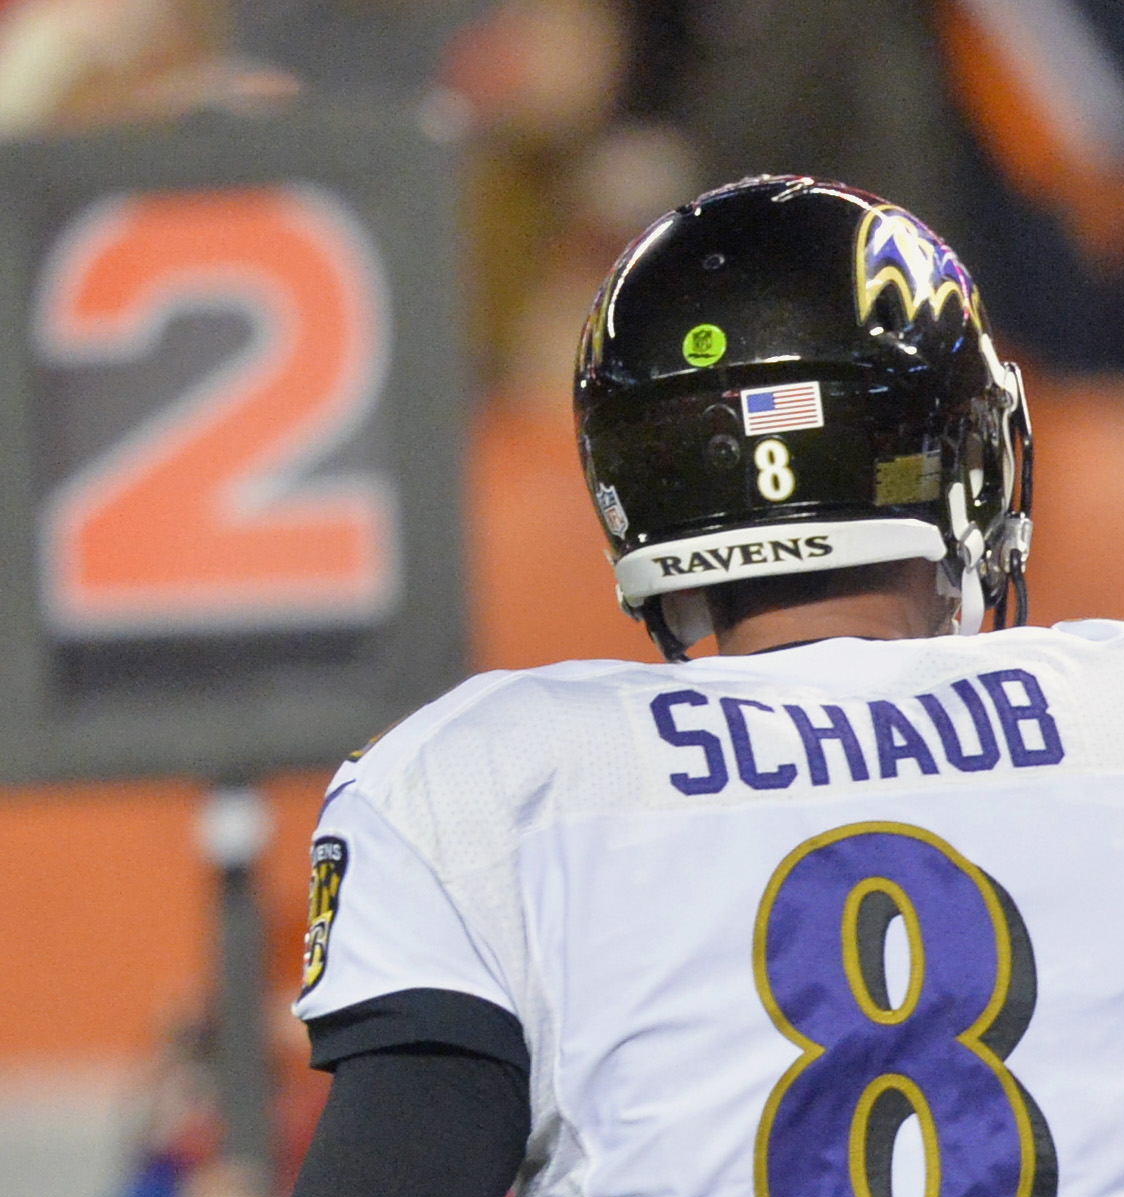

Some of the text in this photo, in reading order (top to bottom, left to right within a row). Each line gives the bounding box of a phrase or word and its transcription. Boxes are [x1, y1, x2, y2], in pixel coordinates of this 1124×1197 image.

[36, 186, 398, 632] 2
[754, 438, 796, 502] 8
[652, 535, 834, 578] RAVENS
[649, 667, 1066, 797] SCHAUB
